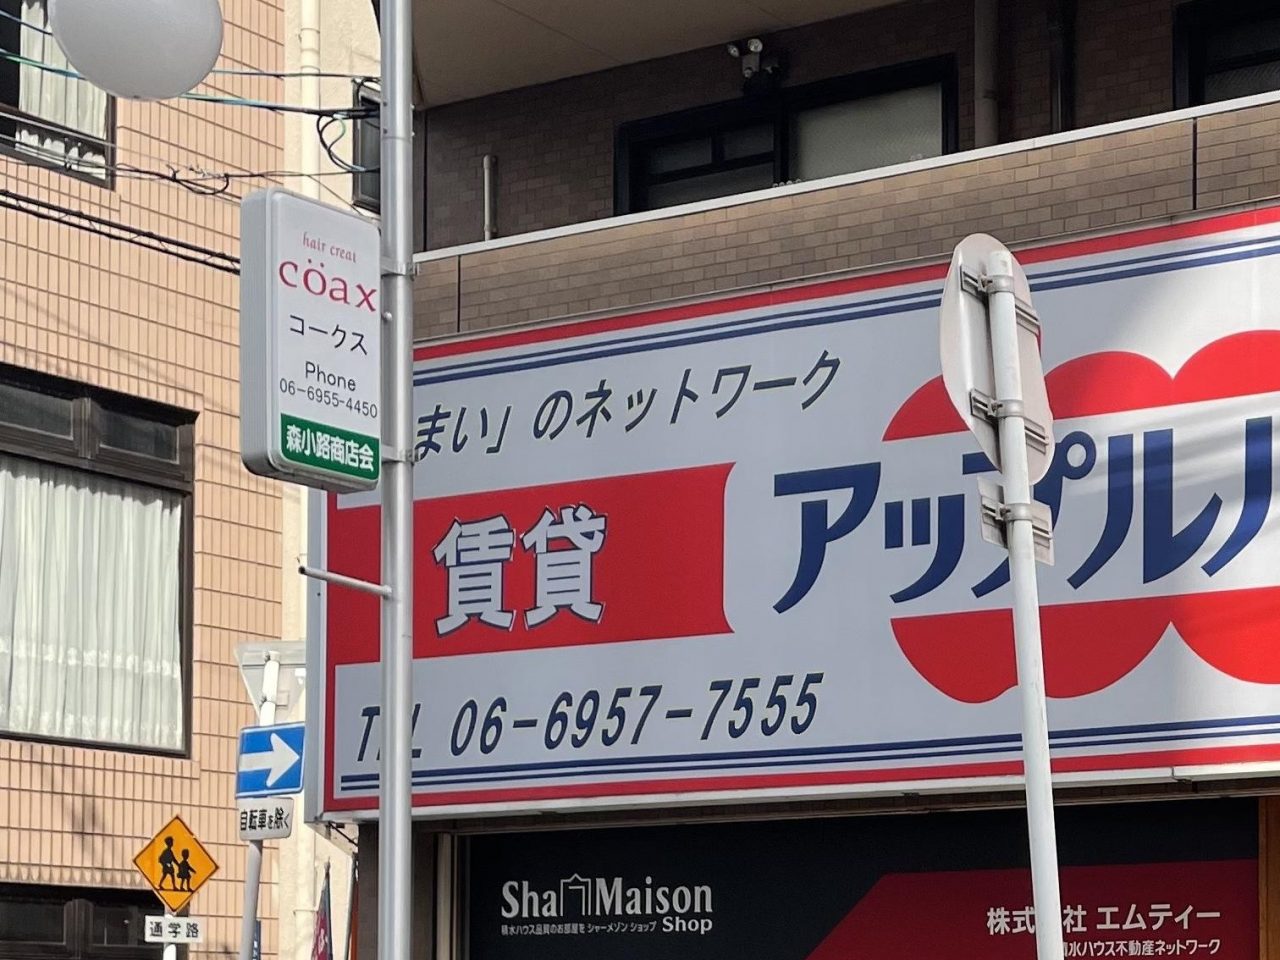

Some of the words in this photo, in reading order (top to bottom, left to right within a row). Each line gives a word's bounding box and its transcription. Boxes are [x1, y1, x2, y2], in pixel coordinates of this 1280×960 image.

[302, 231, 326, 252] hair
[290, 314, 367, 356] コークス
[305, 361, 356, 391] Phone
[280, 378, 377, 418] 06-6955-4450
[286, 424, 374, 472] 森小路商店会
[433, 503, 608, 637] 賃貸
[357, 704, 422, 763] TL
[450, 673, 824, 756] 06-6957-7555
[240, 807, 290, 831] 自転車を除く
[150, 921, 199, 938] 通学路
[587, 922, 629, 934] シャーメゾン
[630, 920, 657, 933] ショップ
[661, 916, 713, 935] Shop
[987, 905, 1087, 935] 株式社
[1096, 904, 1221, 931] エムティー
